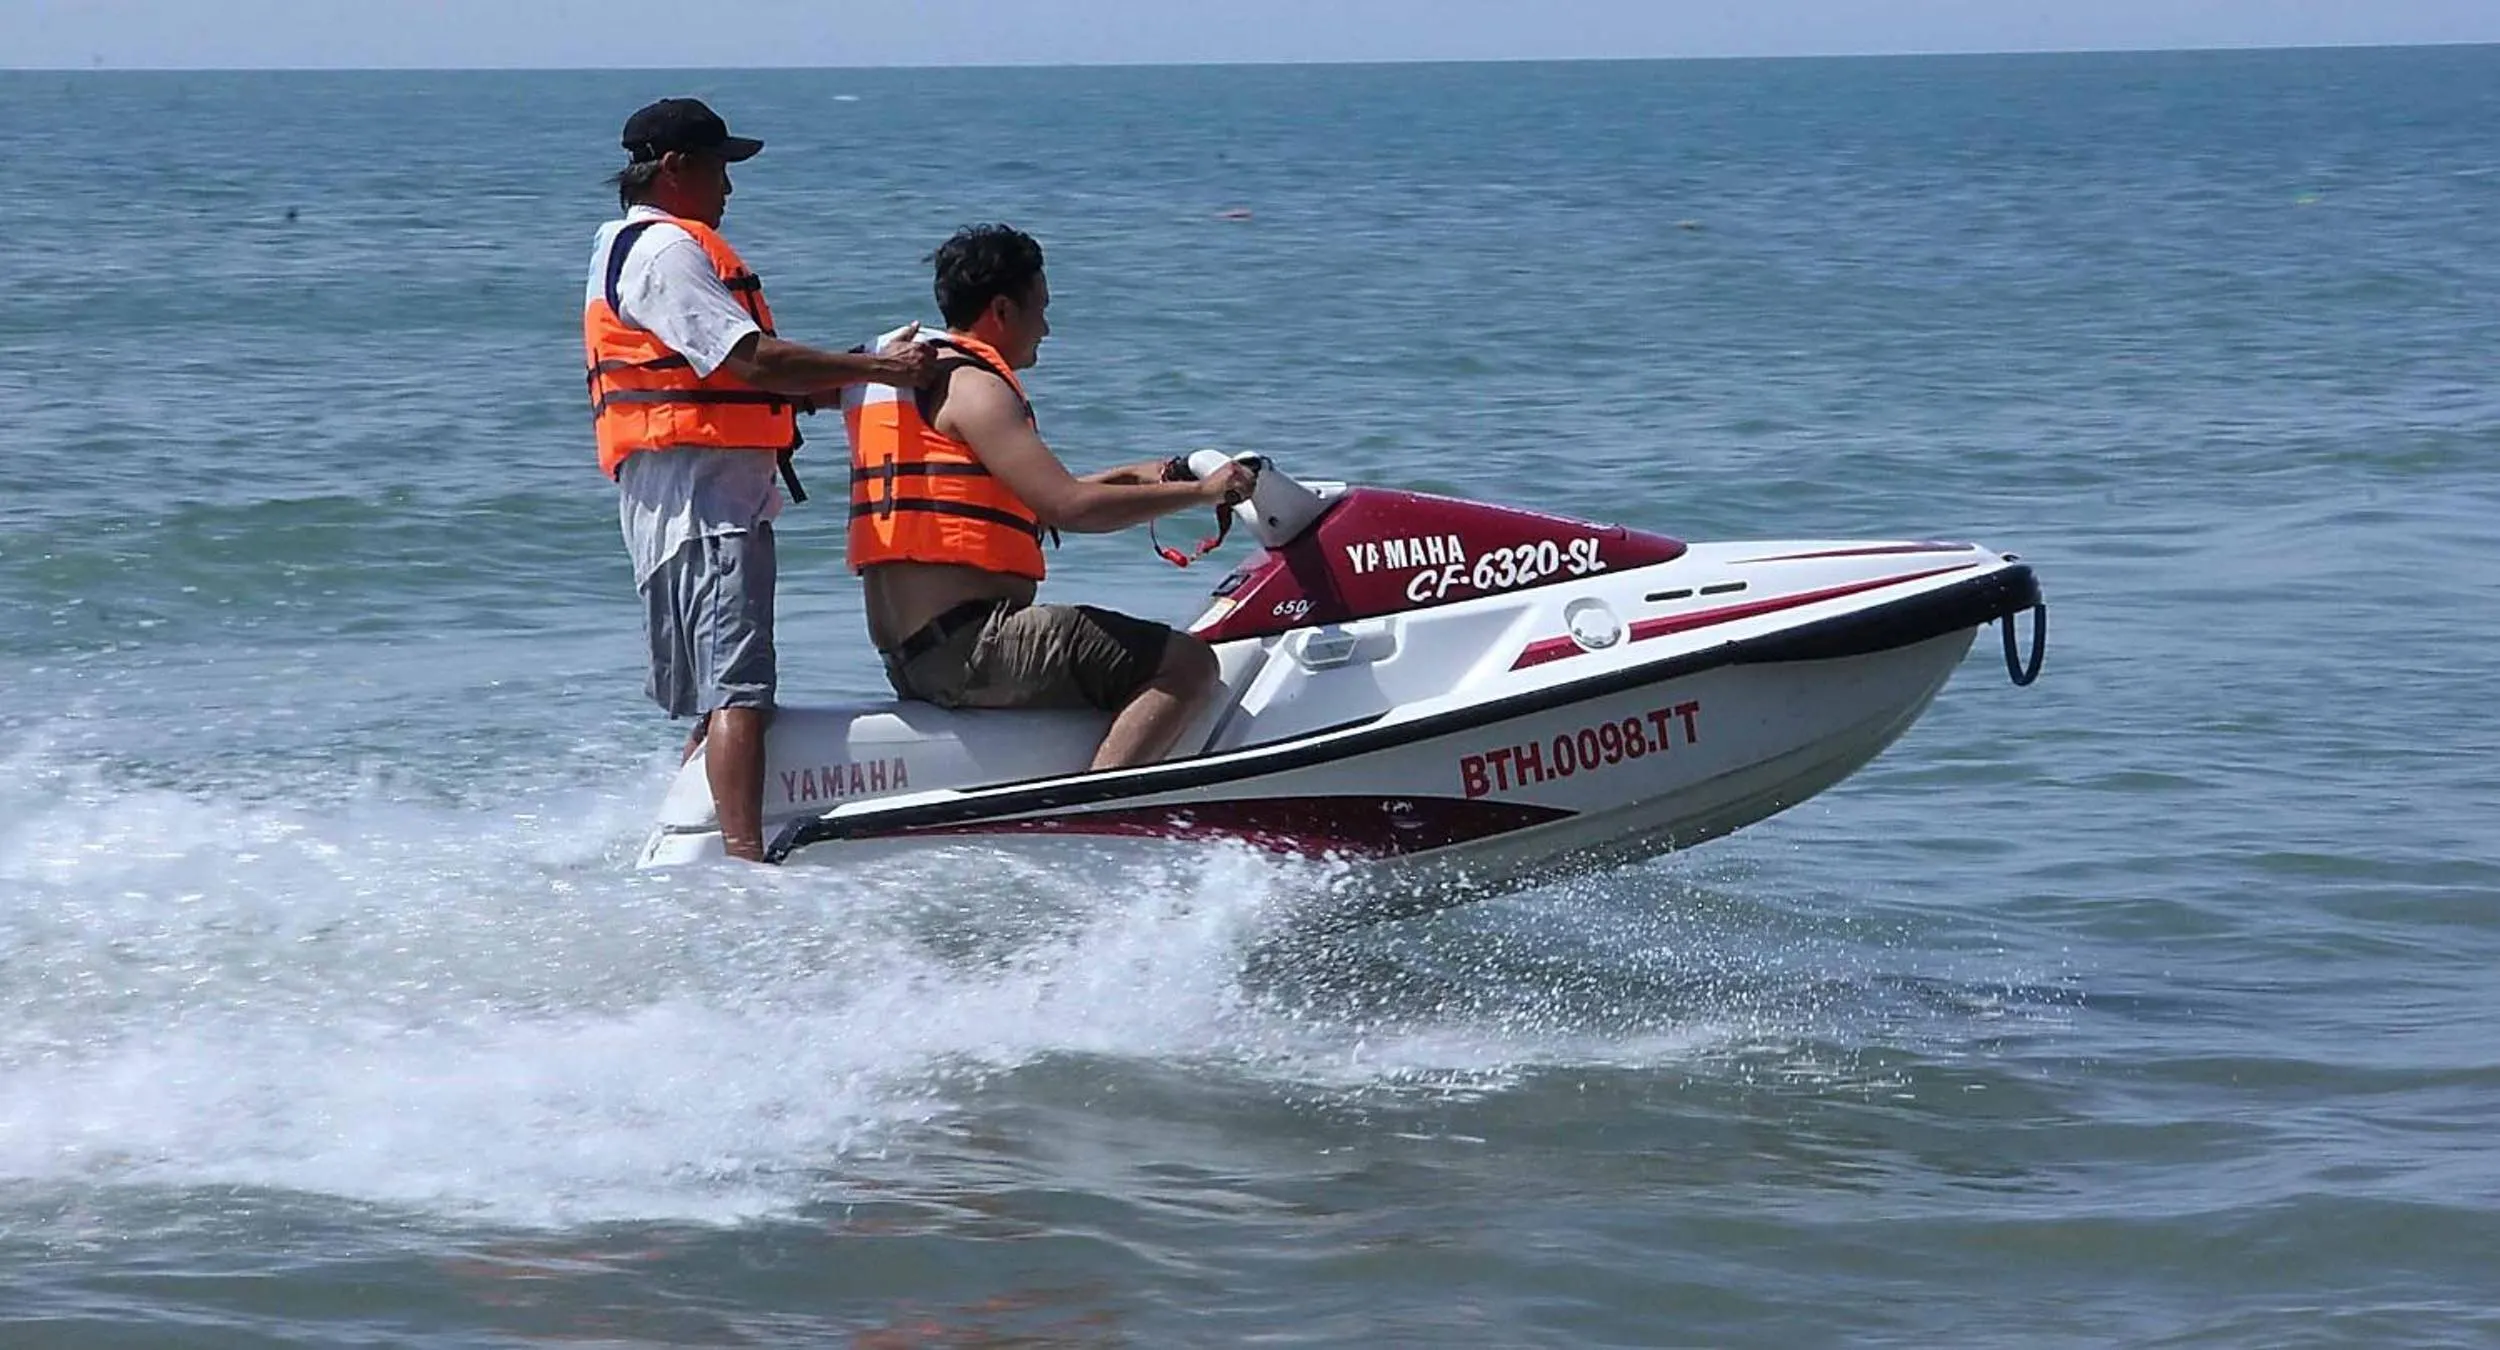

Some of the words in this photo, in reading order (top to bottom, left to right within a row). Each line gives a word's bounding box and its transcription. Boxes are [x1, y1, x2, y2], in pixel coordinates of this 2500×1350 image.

[1406, 537, 1607, 602] CF-6320-SL
[780, 757, 909, 803] YAMAHA
[1460, 700, 1701, 799] BTH.0098.TT
